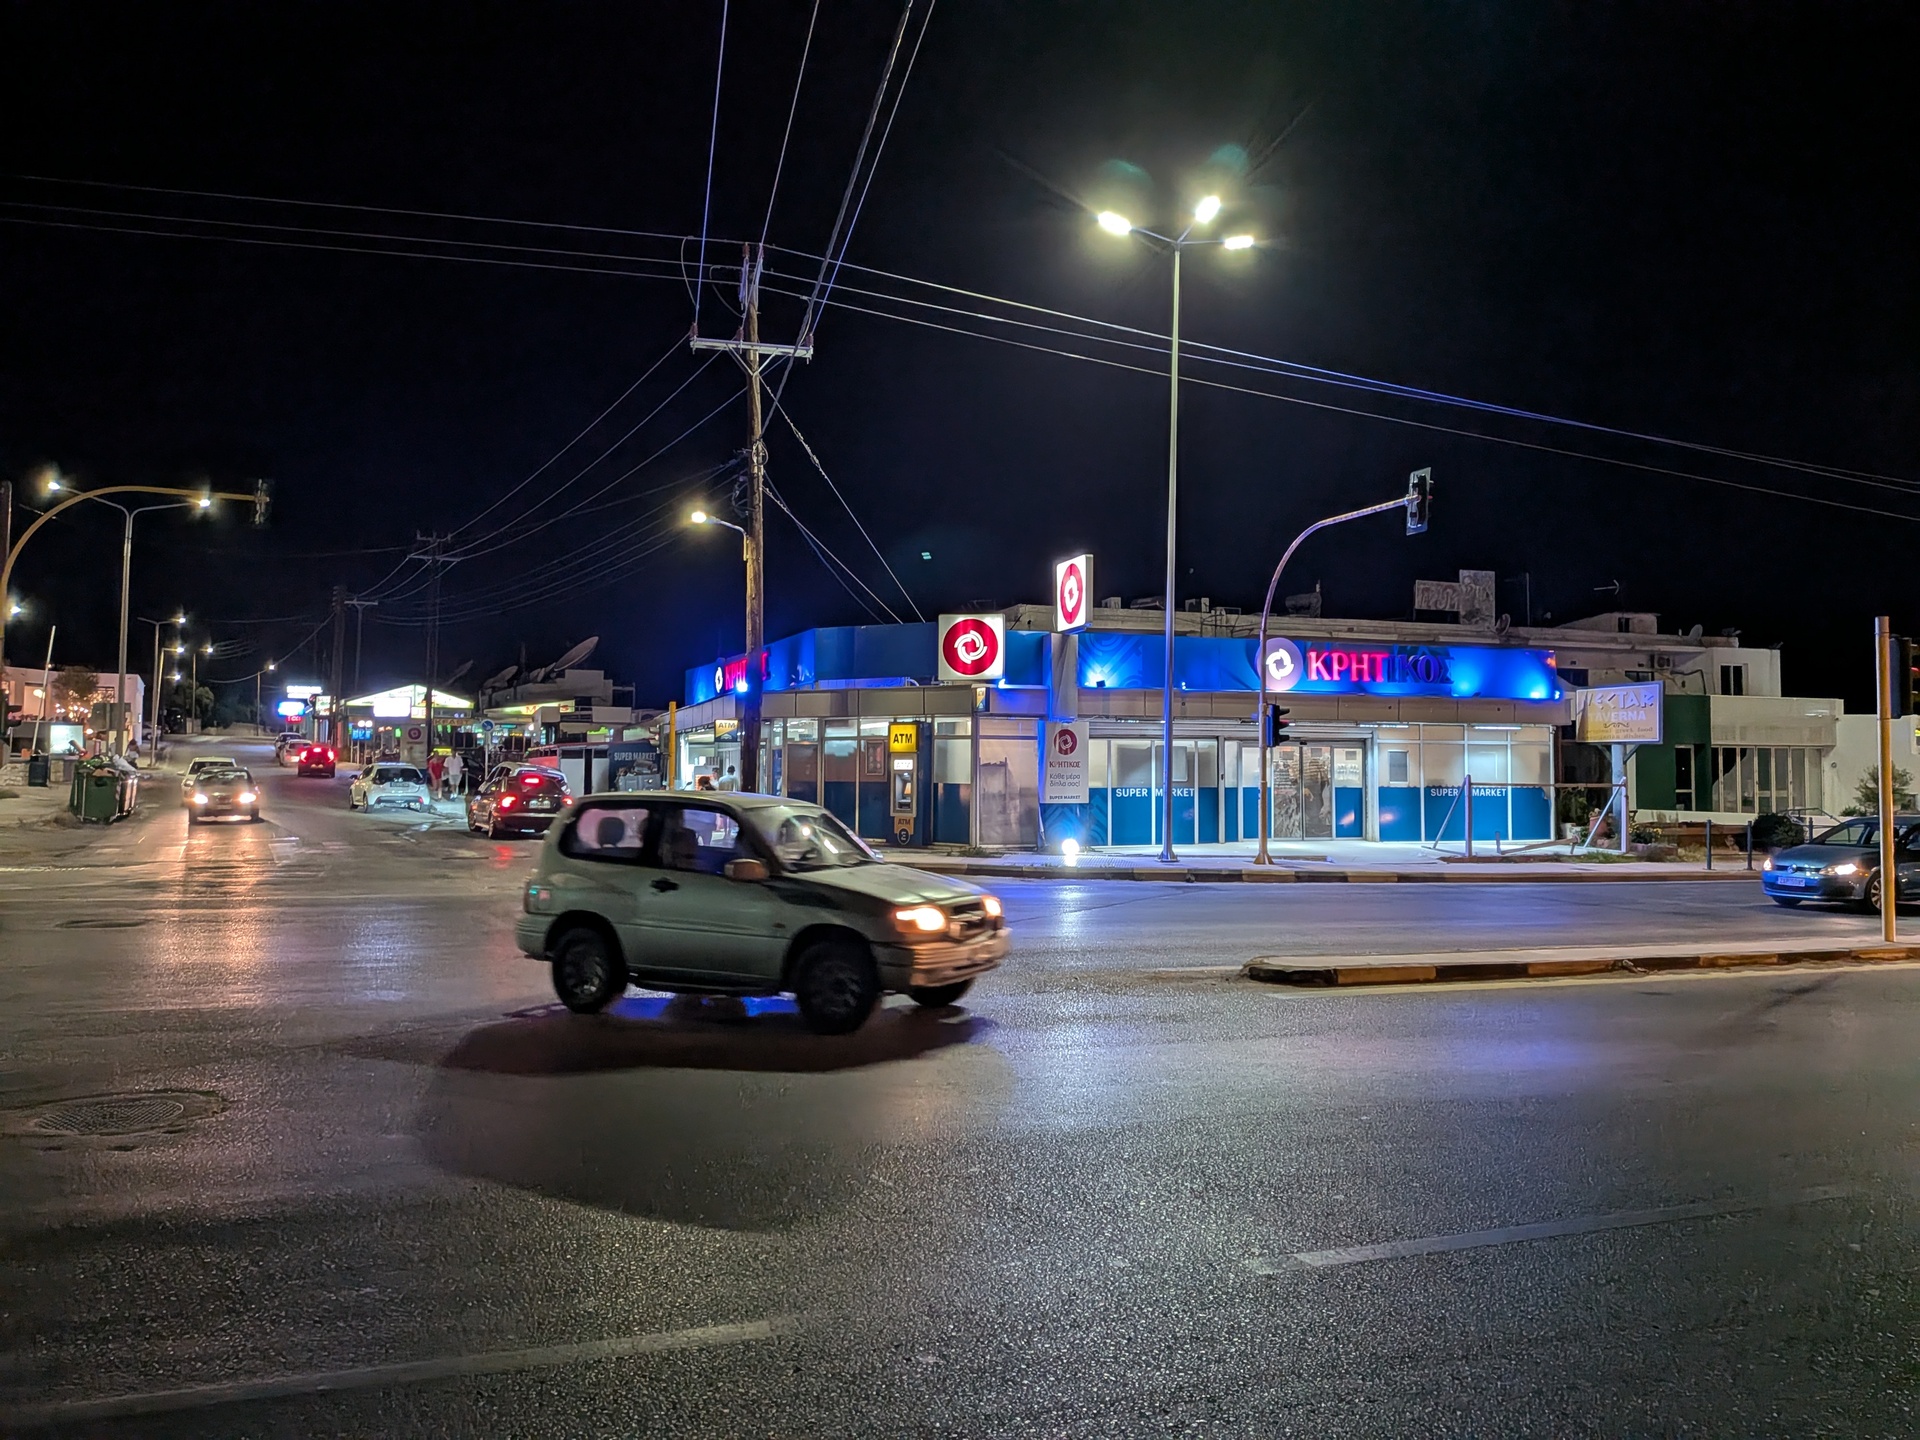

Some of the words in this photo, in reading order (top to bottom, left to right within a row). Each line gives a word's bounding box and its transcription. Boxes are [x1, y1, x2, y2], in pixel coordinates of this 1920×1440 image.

[1308, 650, 1454, 684] ΚΡΗΤΙΚΟΣ
[893, 734, 912, 743] ATM
[614, 752, 632, 760] SUPER
[633, 752, 656, 760] MARKET
[1116, 788, 1148, 797] SUPER
[1155, 788, 1195, 797] MRKET
[1430, 788, 1459, 797] SUPER
[1472, 788, 1507, 797] MARKET
[897, 818, 911, 826] ATM
